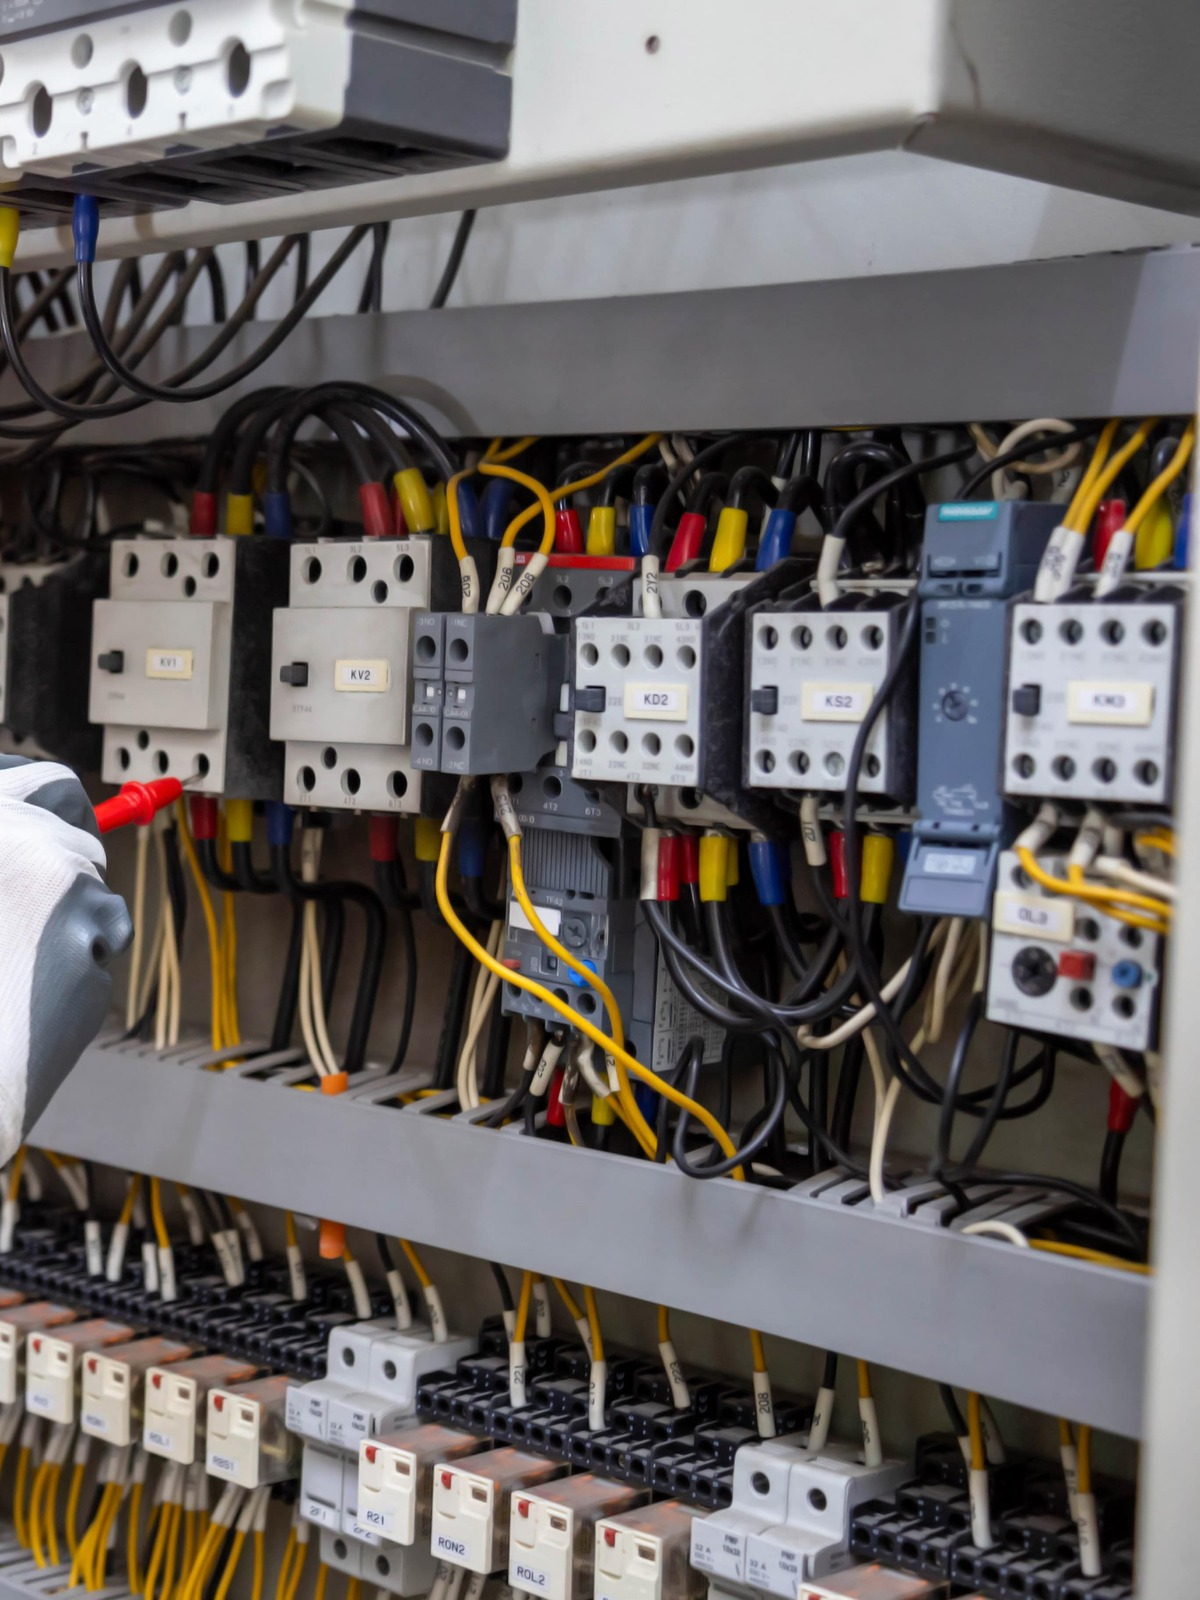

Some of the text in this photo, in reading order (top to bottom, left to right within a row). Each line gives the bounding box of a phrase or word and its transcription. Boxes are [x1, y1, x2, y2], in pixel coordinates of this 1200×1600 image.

[498, 566, 512, 592] 206
[516, 571, 537, 596] 206
[646, 571, 658, 595] 2Y2
[349, 669, 372, 682] KV2
[643, 693, 670, 706] KD2
[825, 695, 854, 709] KS2
[542, 801, 558, 812] 4T2
[585, 806, 601, 817] 6T3
[514, 1364, 524, 1385] 221
[758, 1391, 771, 1415] 208
[309, 1505, 327, 1520] 2F1
[366, 1510, 385, 1526] R21
